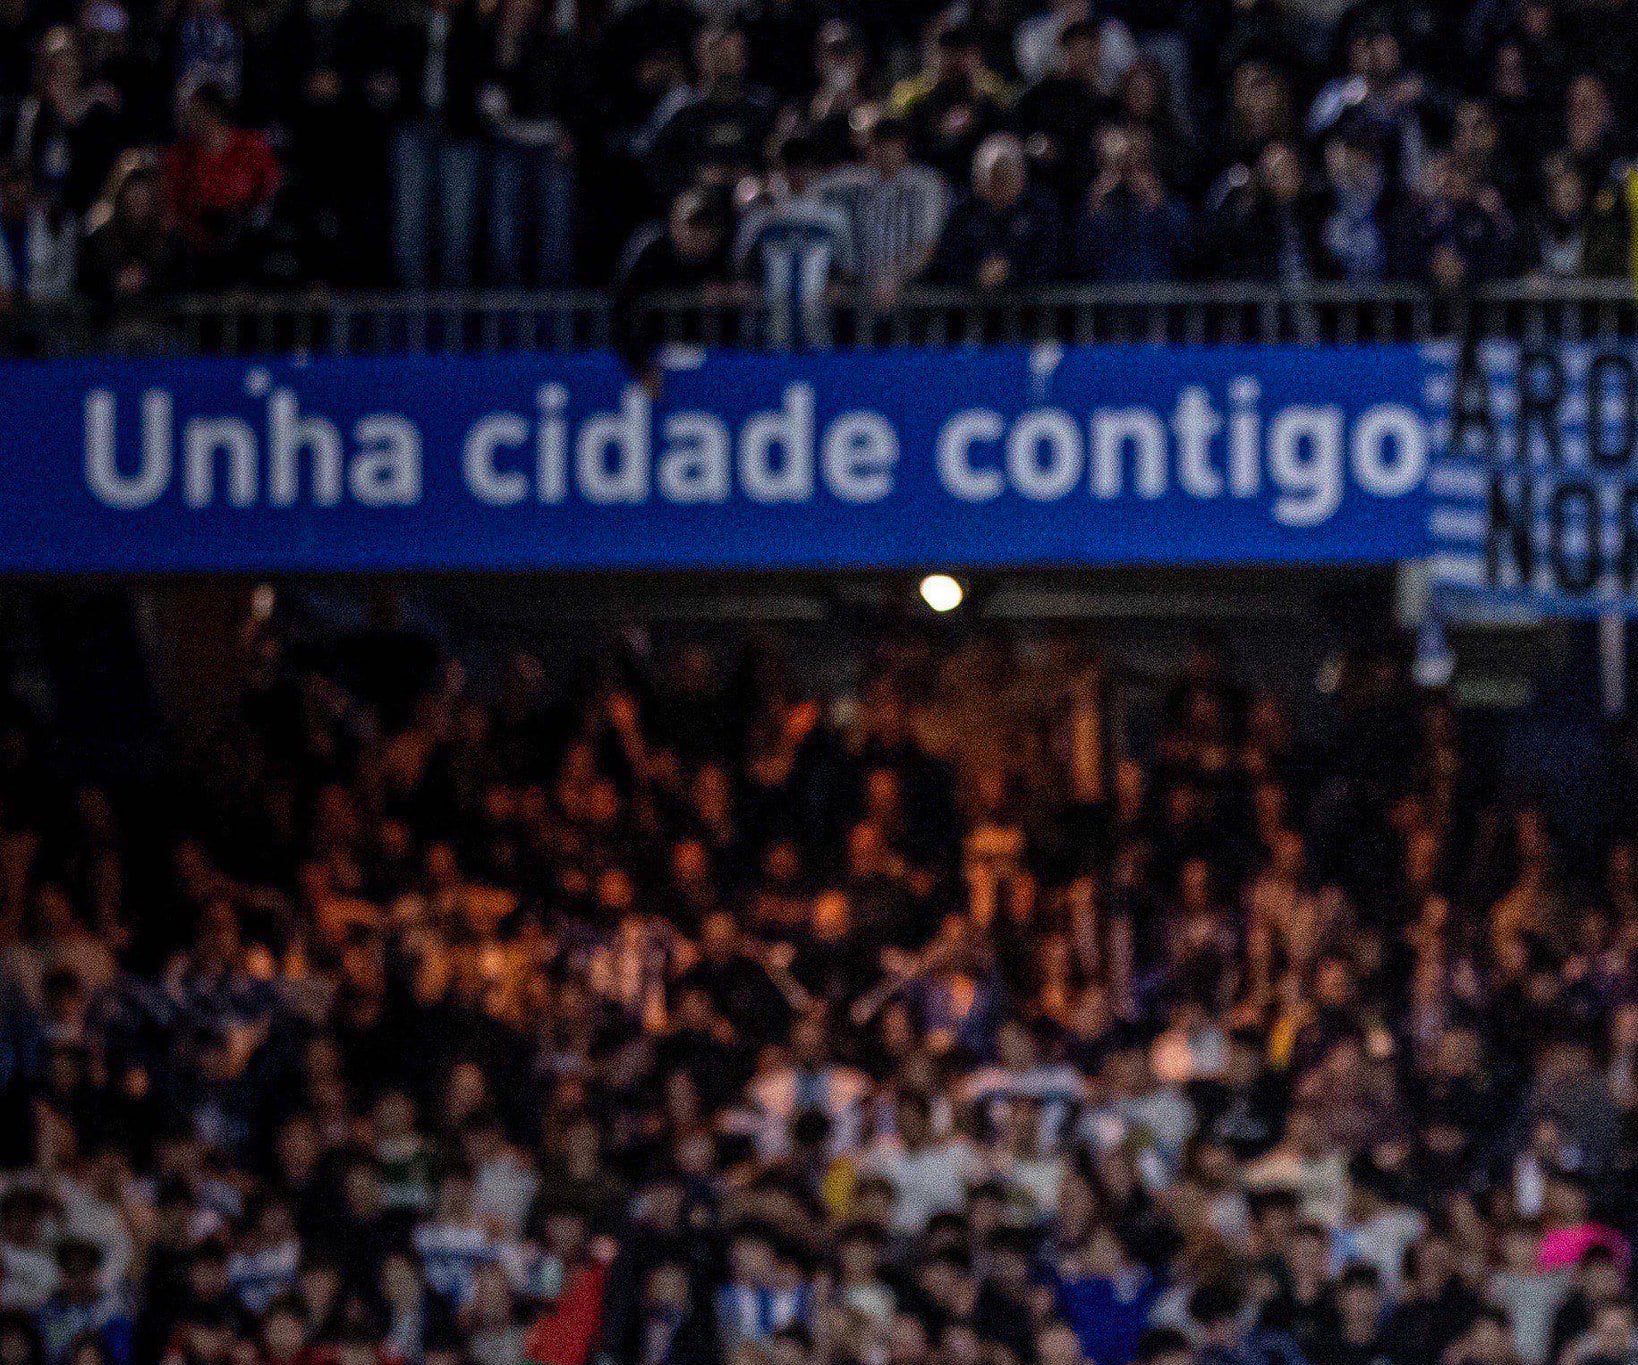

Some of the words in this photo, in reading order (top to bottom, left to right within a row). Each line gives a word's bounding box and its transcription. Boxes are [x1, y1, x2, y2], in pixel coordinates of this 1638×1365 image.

[83, 386, 424, 509] Unha
[461, 381, 901, 506] cidade
[935, 375, 1432, 527] contigo
